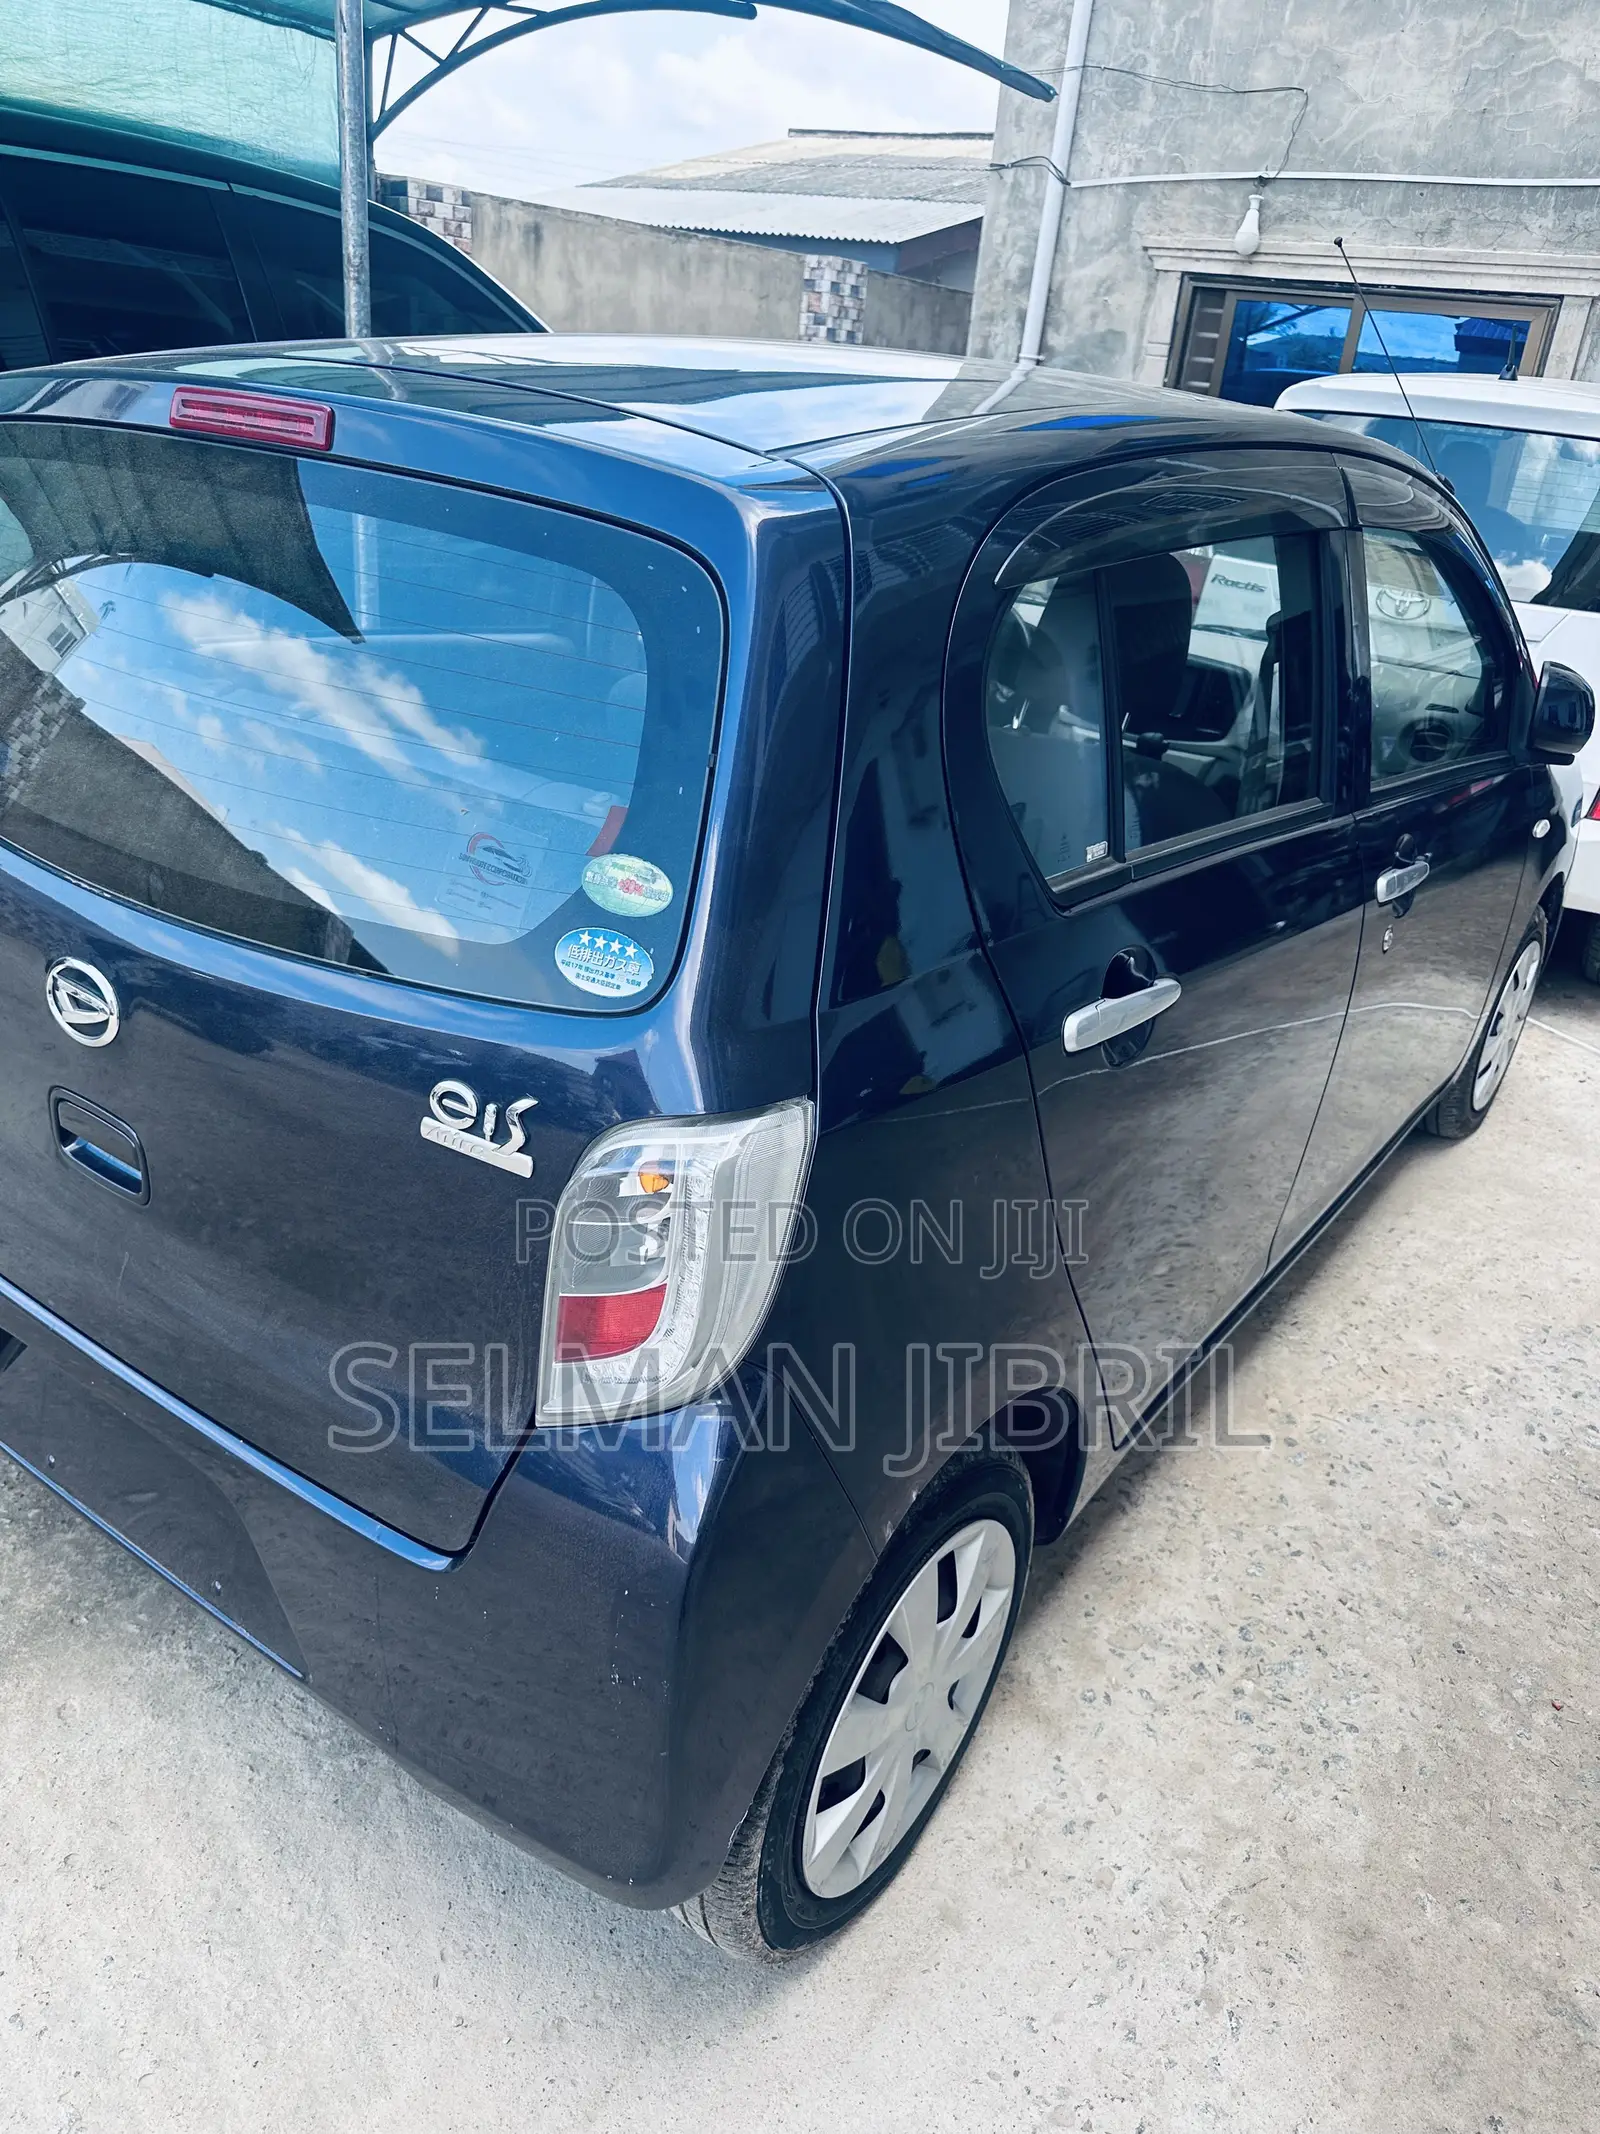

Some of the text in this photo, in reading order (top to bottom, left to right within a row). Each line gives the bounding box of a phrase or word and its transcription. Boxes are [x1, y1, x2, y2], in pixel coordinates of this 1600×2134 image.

[1210, 573, 1268, 593] Ractis
[568, 944, 642, 976] 低排出ガス車
